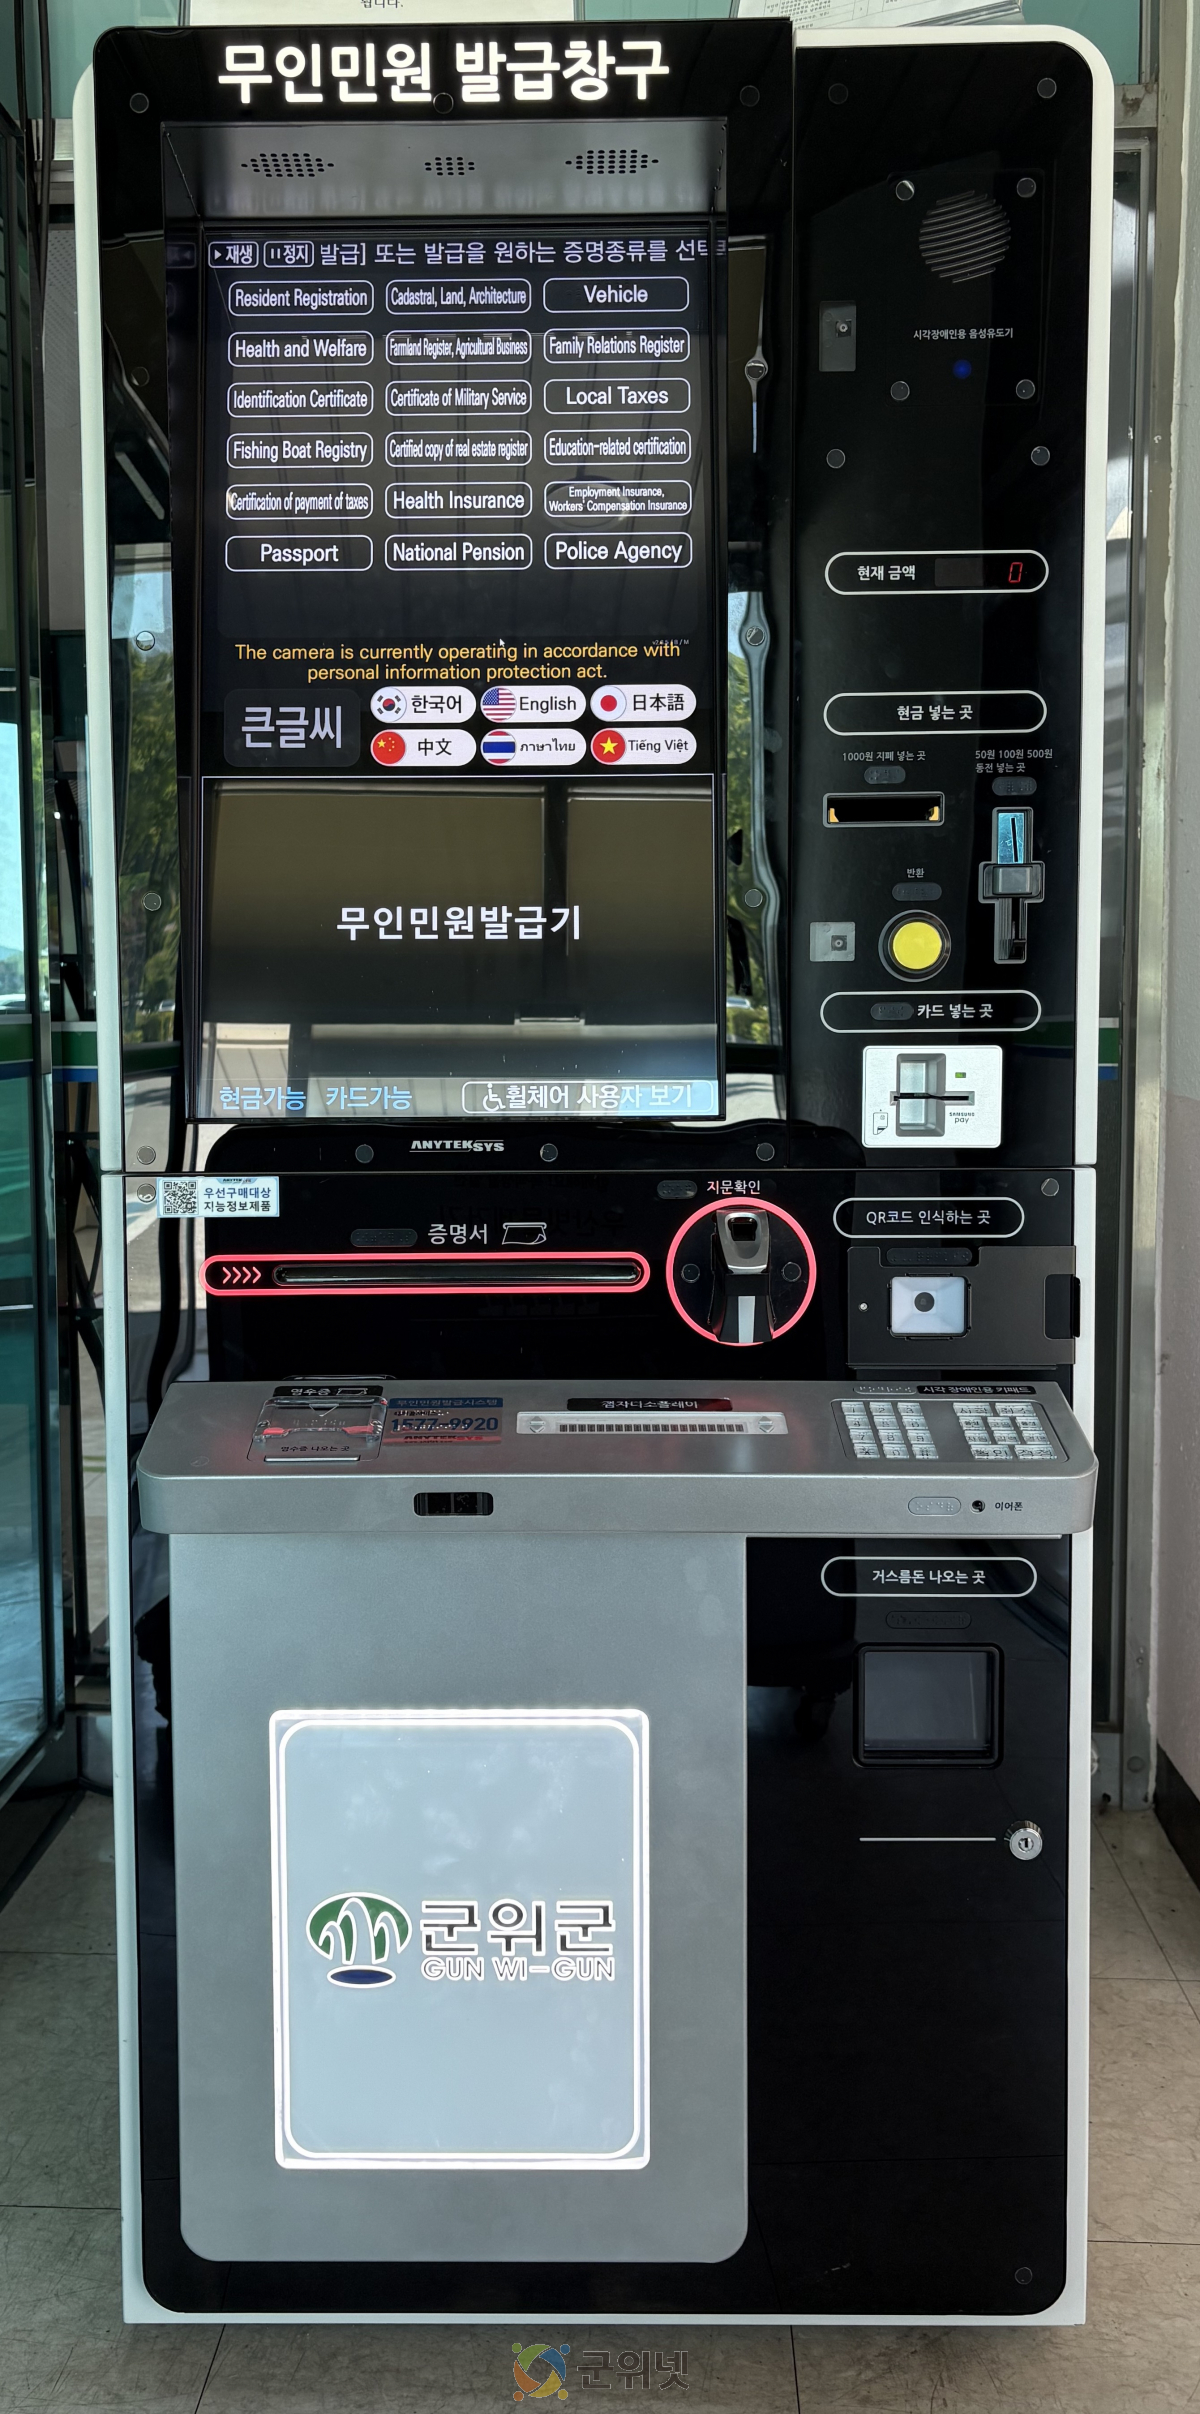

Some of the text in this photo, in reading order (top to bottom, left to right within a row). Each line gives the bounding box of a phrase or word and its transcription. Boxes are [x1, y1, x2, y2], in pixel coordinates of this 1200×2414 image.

[218, 39, 670, 104] 무인민원 발급창구
[225, 244, 253, 265] 재생
[283, 244, 309, 265] 정지
[320, 242, 366, 266] 발급]
[374, 243, 417, 265] 또는
[424, 241, 487, 265] 발급을
[493, 241, 557, 264] 원하는
[563, 240, 669, 264] 증명종류를
[235, 287, 368, 310] Resident Registration
[391, 286, 527, 308] Cadastral, Land, Architecture
[583, 284, 649, 304] Vehicle
[913, 327, 1013, 341] 시각장애인용 음성유도기
[235, 338, 367, 358] Health and Welfare
[389, 337, 528, 360] Farmland Register, Agricultural Business
[549, 335, 685, 359] Family Relations Register
[233, 388, 368, 409] Identification Certificate
[390, 387, 527, 410] Certificate of Military Service
[566, 385, 669, 405] Local Taxes
[233, 439, 368, 463] Fishing Boat Registry
[389, 438, 528, 462] Certified copy of real estate register
[549, 436, 687, 457] Education-related certification
[393, 490, 525, 510] Health Insurance
[568, 485, 665, 499] Employment Insurance,
[230, 491, 369, 514] Certification of payment of taxes
[586, 499, 646, 514] Compensation
[647, 499, 689, 512] Insurance
[260, 543, 339, 567] Passport
[393, 541, 525, 562] National Pension
[555, 540, 683, 564] Police Agency
[857, 564, 916, 581] 현재 금액
[1008, 561, 1024, 583] 0
[234, 639, 683, 664] The camera is currently operating in accordance with
[308, 662, 607, 684] personal information protection act.
[411, 694, 462, 714] 한국어
[519, 695, 577, 714] English
[633, 692, 685, 712] 日本語
[896, 704, 973, 721] 현금 넣는 곳
[241, 705, 342, 749] 큰글씨
[417, 737, 452, 757] 中文
[520, 737, 576, 752] ภาษาไทย
[628, 738, 689, 754] Tiếng Việt
[975, 748, 1053, 760] 50원 100원 500원
[842, 750, 926, 762] 1000원 지폐 넣는 곳
[975, 762, 1026, 774] 동전 넣는 곳
[906, 867, 925, 878] 반환
[336, 905, 580, 941] 무인민원발급기
[917, 1003, 994, 1019] 카드 넣는 곳
[219, 1085, 413, 1111] 현금가능 카드가능
[506, 1083, 694, 1109] 휠체어 사용자 보기
[203, 1187, 272, 1199] 우선구매대상
[706, 1179, 760, 1195] 지문확인
[204, 1200, 271, 1213] 지능정보제품
[866, 1210, 991, 1226] QR코드 인식하는 곳
[427, 1223, 488, 1245] 증명서
[391, 1417, 499, 1432] 1577-9920
[994, 1501, 1022, 1512] 이어폰
[872, 1569, 986, 1585] 거스름돈 나오는 곳
[419, 1898, 617, 1957] 군위군
[420, 1956, 485, 1982] GUN
